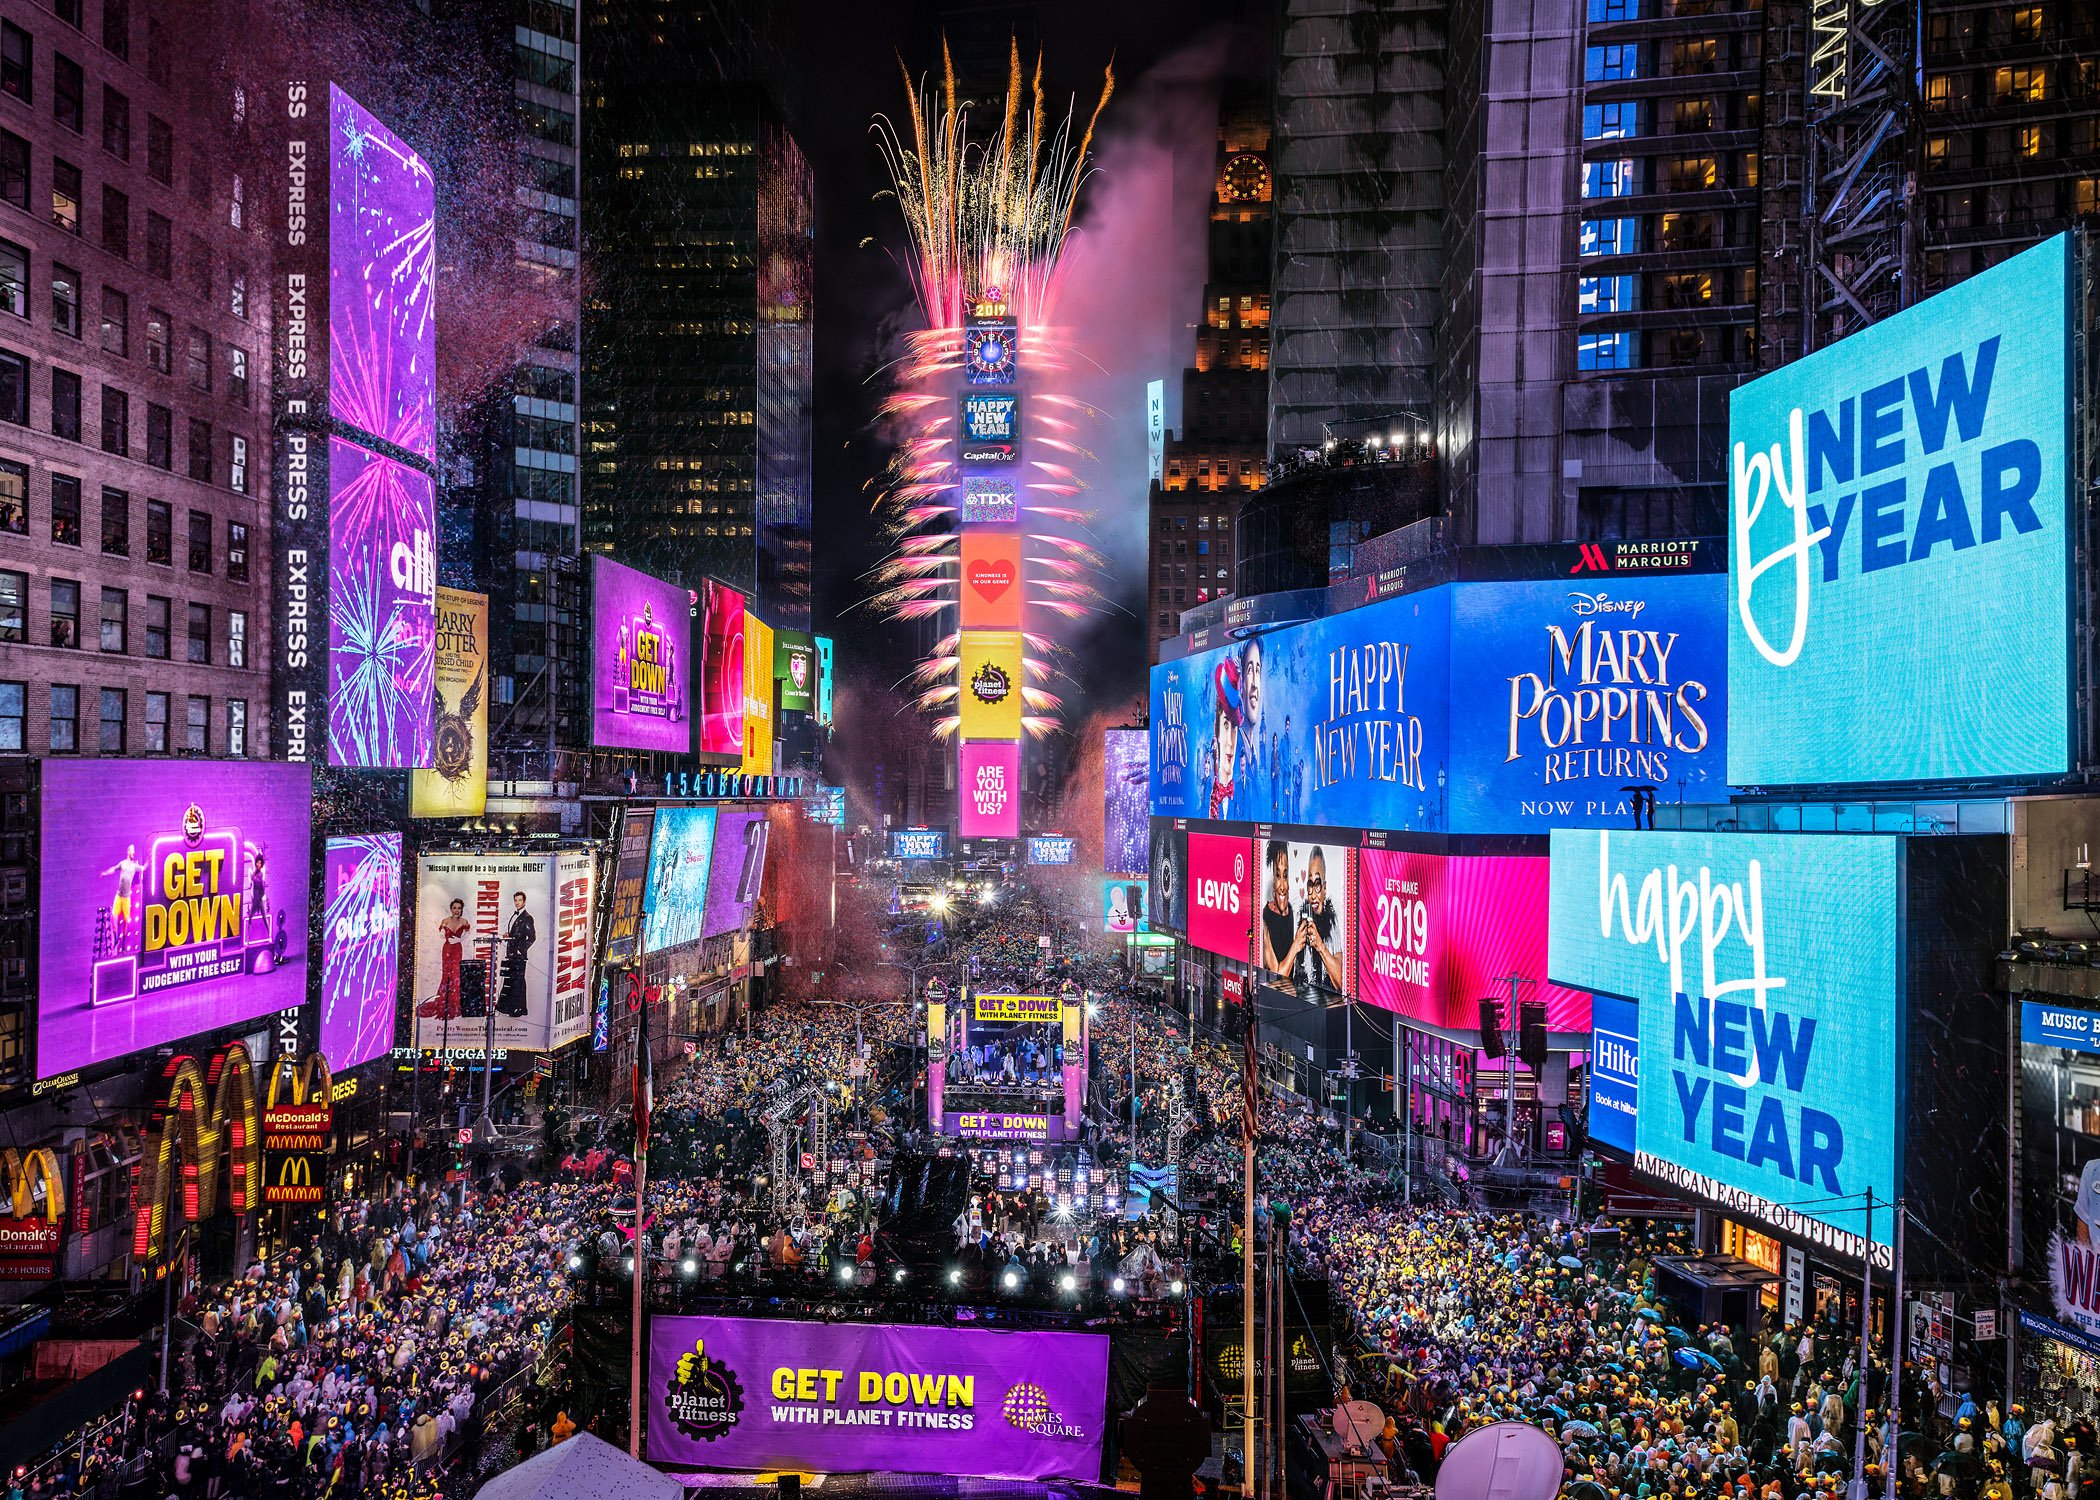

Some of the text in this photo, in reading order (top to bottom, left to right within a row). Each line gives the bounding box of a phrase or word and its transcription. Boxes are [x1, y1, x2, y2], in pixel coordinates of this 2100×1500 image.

[288, 81, 306, 118] SS
[288, 141, 306, 246] EXPRESS
[976, 304, 1006, 316] 2019
[288, 274, 306, 379] EXPRESS
[967, 401, 1014, 413] HAPPY
[1807, 334, 2002, 495] NEW
[974, 412, 1007, 424] NEW
[1151, 399, 1161, 442] NEW
[969, 423, 1010, 435] YEAR!
[288, 400, 307, 520] EPRESS
[978, 494, 1014, 505] TDK
[1807, 438, 2044, 583] YEAR
[1617, 541, 1699, 554] MARRIOTT
[1617, 555, 1689, 568] MARQUIS
[1380, 566, 1407, 580] MARRIOTT
[1380, 580, 1404, 594] MARQUIS
[288, 550, 307, 669] EXPRESS
[435, 631, 479, 655] OTTER
[637, 630, 659, 663] GET
[1545, 620, 1680, 692] MARY
[631, 659, 666, 695] DOWN
[974, 681, 1002, 689] planet
[1329, 641, 1411, 724] HAPPY
[978, 686, 1007, 695] fitness
[1503, 672, 1708, 763] POPPINS
[1313, 716, 1427, 791] NEW YEAR
[976, 766, 1004, 779] ARE
[1544, 749, 1668, 785] RETURNS
[976, 778, 1004, 791] YOU
[973, 790, 1007, 803] WITH
[977, 803, 1003, 815] US?
[1521, 801, 1573, 816] NOW
[900, 835, 937, 843] HAPPY
[1034, 841, 1072, 849] HAPPY
[163, 849, 225, 900] GET
[457, 865, 473, 873] would
[488, 865, 496, 873] big
[616, 877, 642, 899] COME
[1385, 878, 1419, 895] LET'S MAKE
[476, 880, 500, 935] PRETTY
[145, 893, 241, 951] DOWN
[610, 916, 637, 939] AWAY
[1376, 894, 1428, 955] 2019
[556, 879, 575, 994] WOMAN
[570, 877, 589, 990] PRETTY
[169, 949, 217, 970] WITH YOUR
[1373, 950, 1430, 987] AWESOME
[142, 958, 241, 990] JUDGEMENT FREE SELF
[979, 999, 1058, 1012] GET DOWN
[2042, 1011, 2088, 1031] MUSIC
[1673, 991, 1817, 1092] NEW
[391, 1048, 422, 1059] FTS
[1599, 1039, 1639, 1078] Hilto
[1595, 1092, 1612, 1108] Book
[1612, 1100, 1620, 1109] at
[265, 1113, 329, 1123] McDonald's
[959, 1115, 1047, 1129] GET DOWN
[983, 1130, 1012, 1138] PLANET
[1672, 1069, 1844, 1197] YEAR
[1636, 1151, 1891, 1269] AMERICAN EAGLE OUTFITTERS
[0, 1229, 57, 1241] Donald's
[20, 1266, 50, 1274] HOURS
[2074, 1312, 2092, 1326] THE
[1291, 1358, 1315, 1366] planet
[771, 1367, 975, 1406] GET DOWN
[672, 1392, 726, 1411] planet
[678, 1405, 736, 1423] fitness
[771, 1406, 974, 1430] WITH PLANET FITNESS
[1021, 1411, 1063, 1424] TIMES
